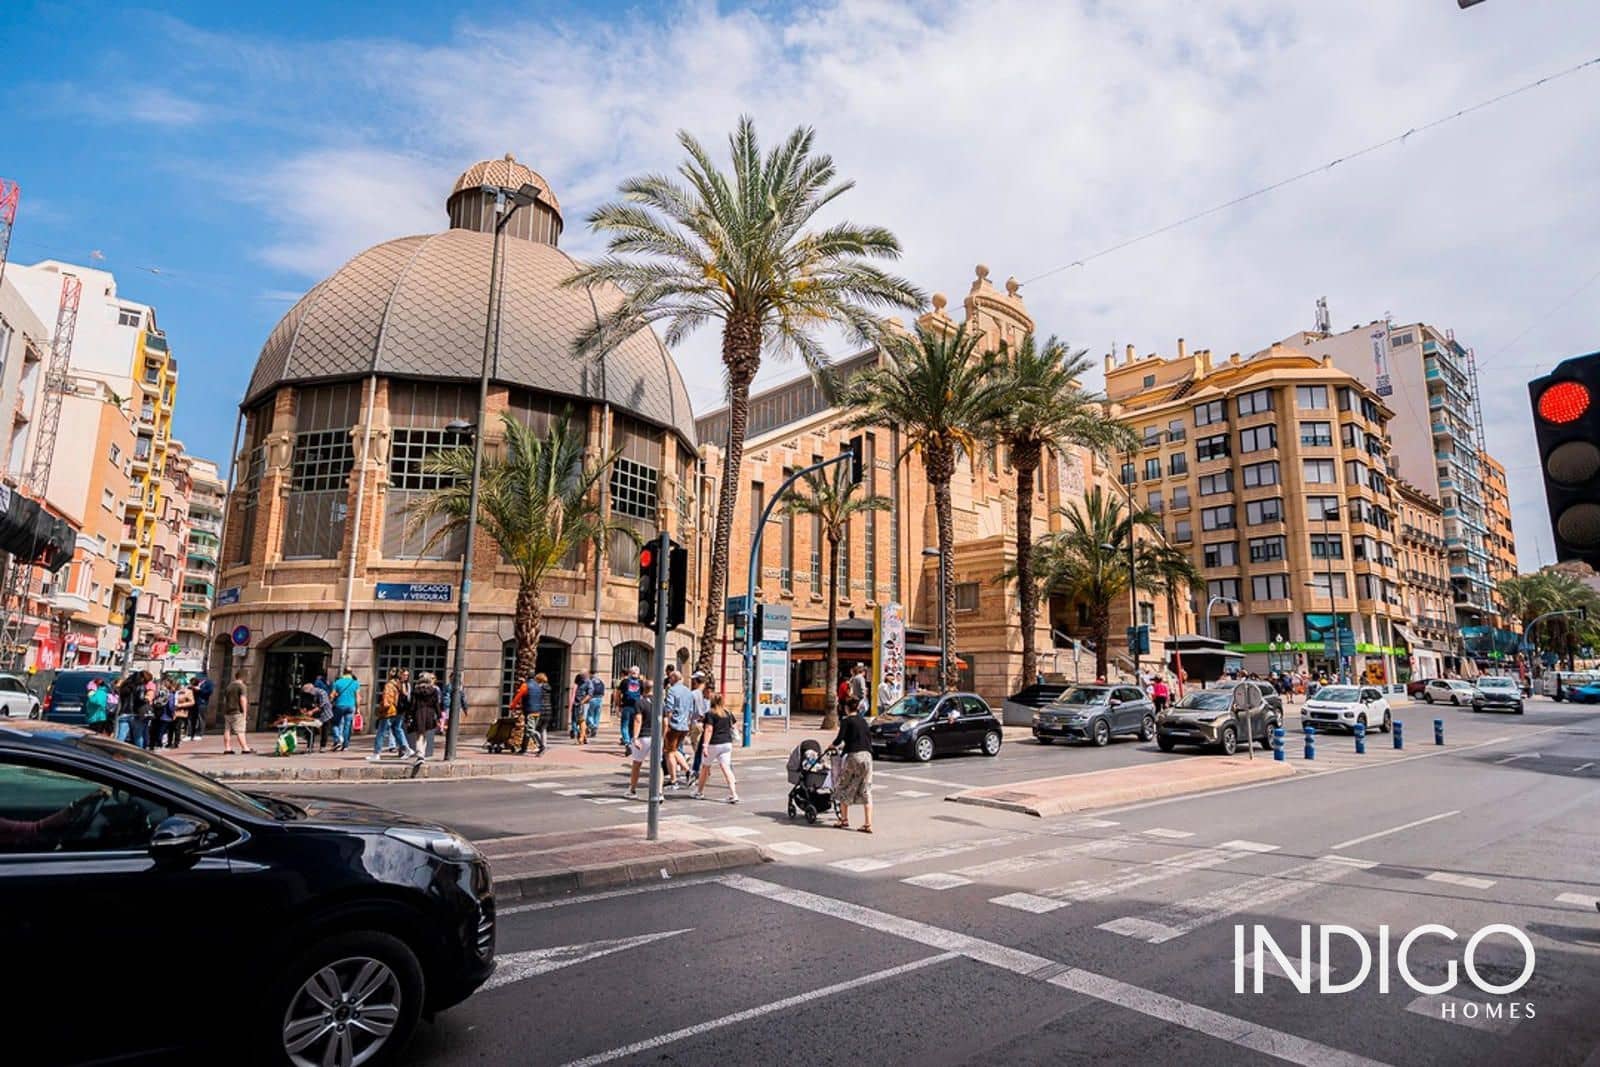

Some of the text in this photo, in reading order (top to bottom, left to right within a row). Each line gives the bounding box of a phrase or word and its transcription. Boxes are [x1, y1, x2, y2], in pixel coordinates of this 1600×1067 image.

[410, 584, 449, 592] PESCADOS
[402, 592, 449, 600] Y VERDURAS
